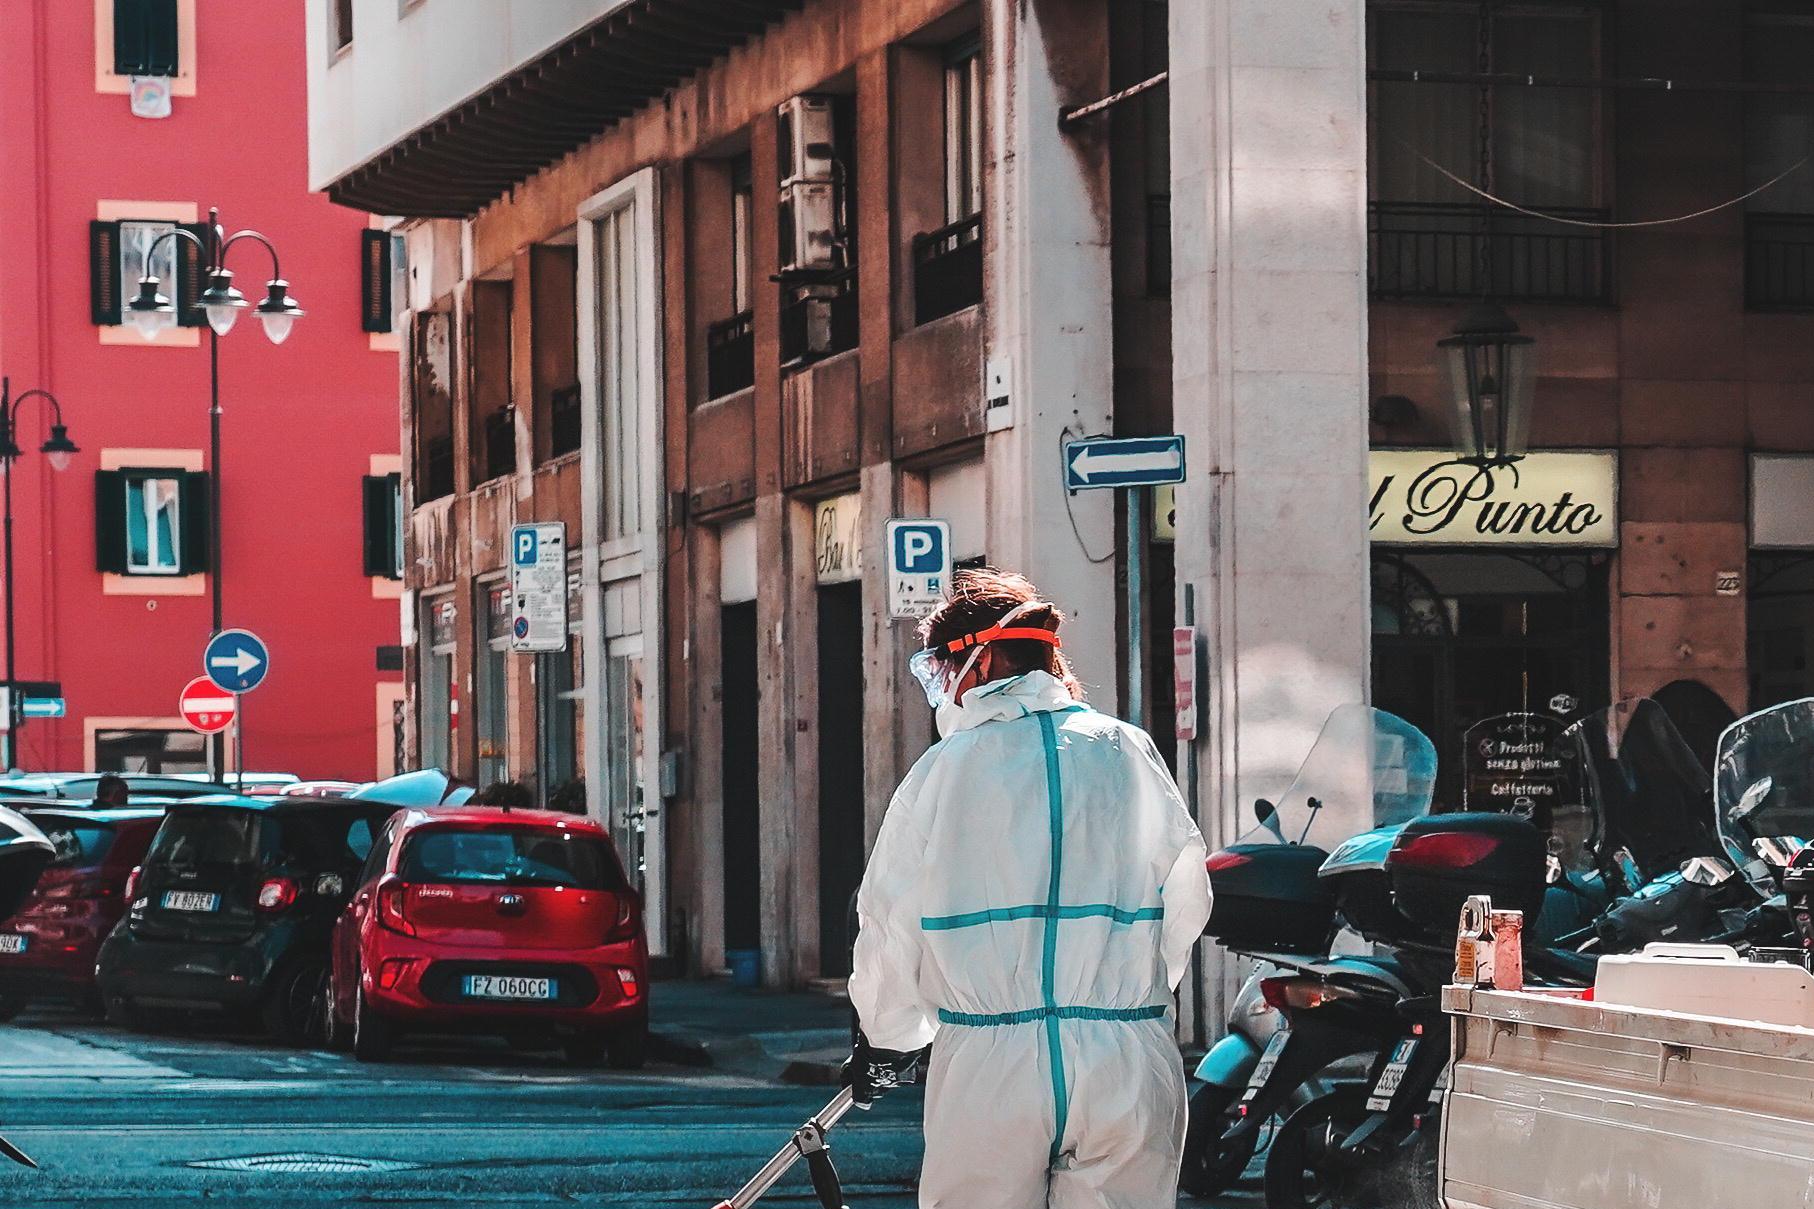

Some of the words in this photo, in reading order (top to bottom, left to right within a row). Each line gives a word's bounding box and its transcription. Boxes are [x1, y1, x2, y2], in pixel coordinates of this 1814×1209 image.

[1402, 458, 1602, 534] Punto
[519, 534, 532, 561] P
[904, 531, 932, 568] P
[1486, 759, 1518, 770] senza
[474, 977, 491, 994] FZ
